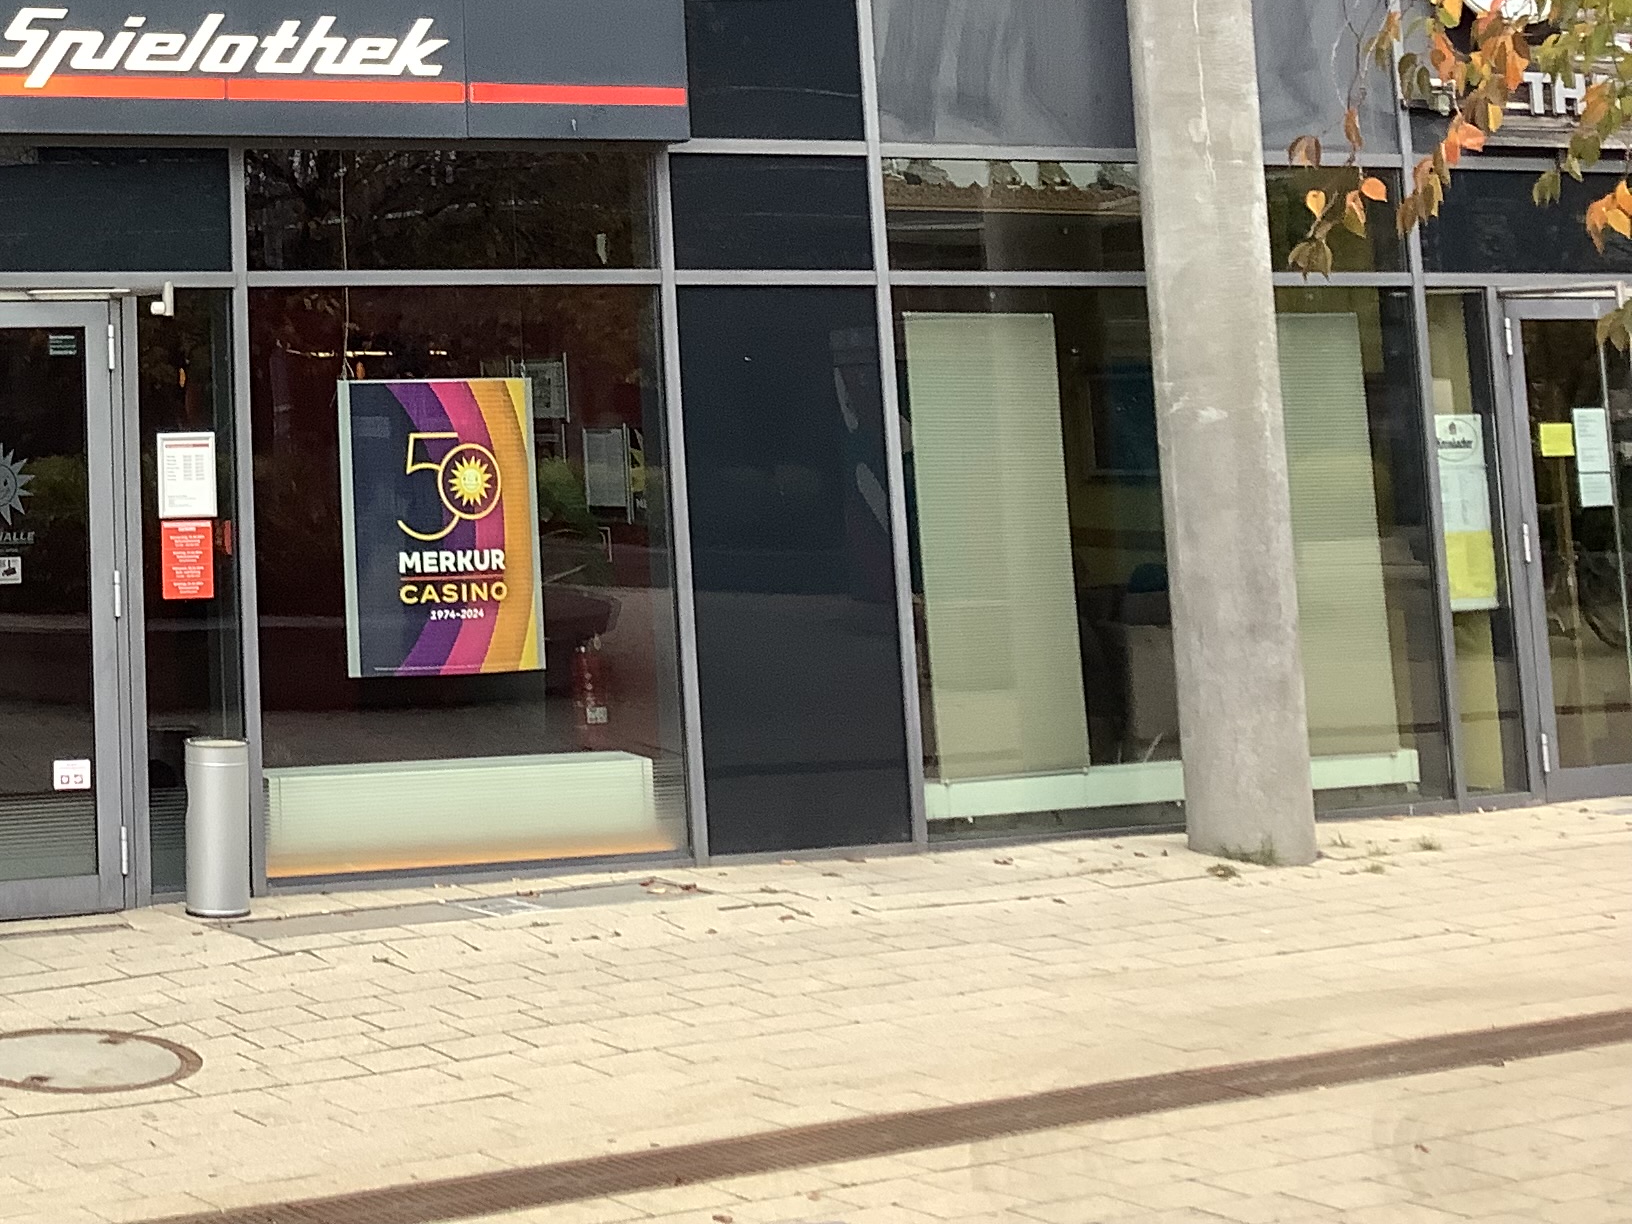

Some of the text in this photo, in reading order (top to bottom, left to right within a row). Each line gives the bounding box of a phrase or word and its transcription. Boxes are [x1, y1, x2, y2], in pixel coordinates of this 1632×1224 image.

[397, 432, 502, 541] 50
[398, 548, 506, 573] MERKUR
[399, 582, 508, 604] CASINO
[429, 608, 484, 620] 1974-2024
